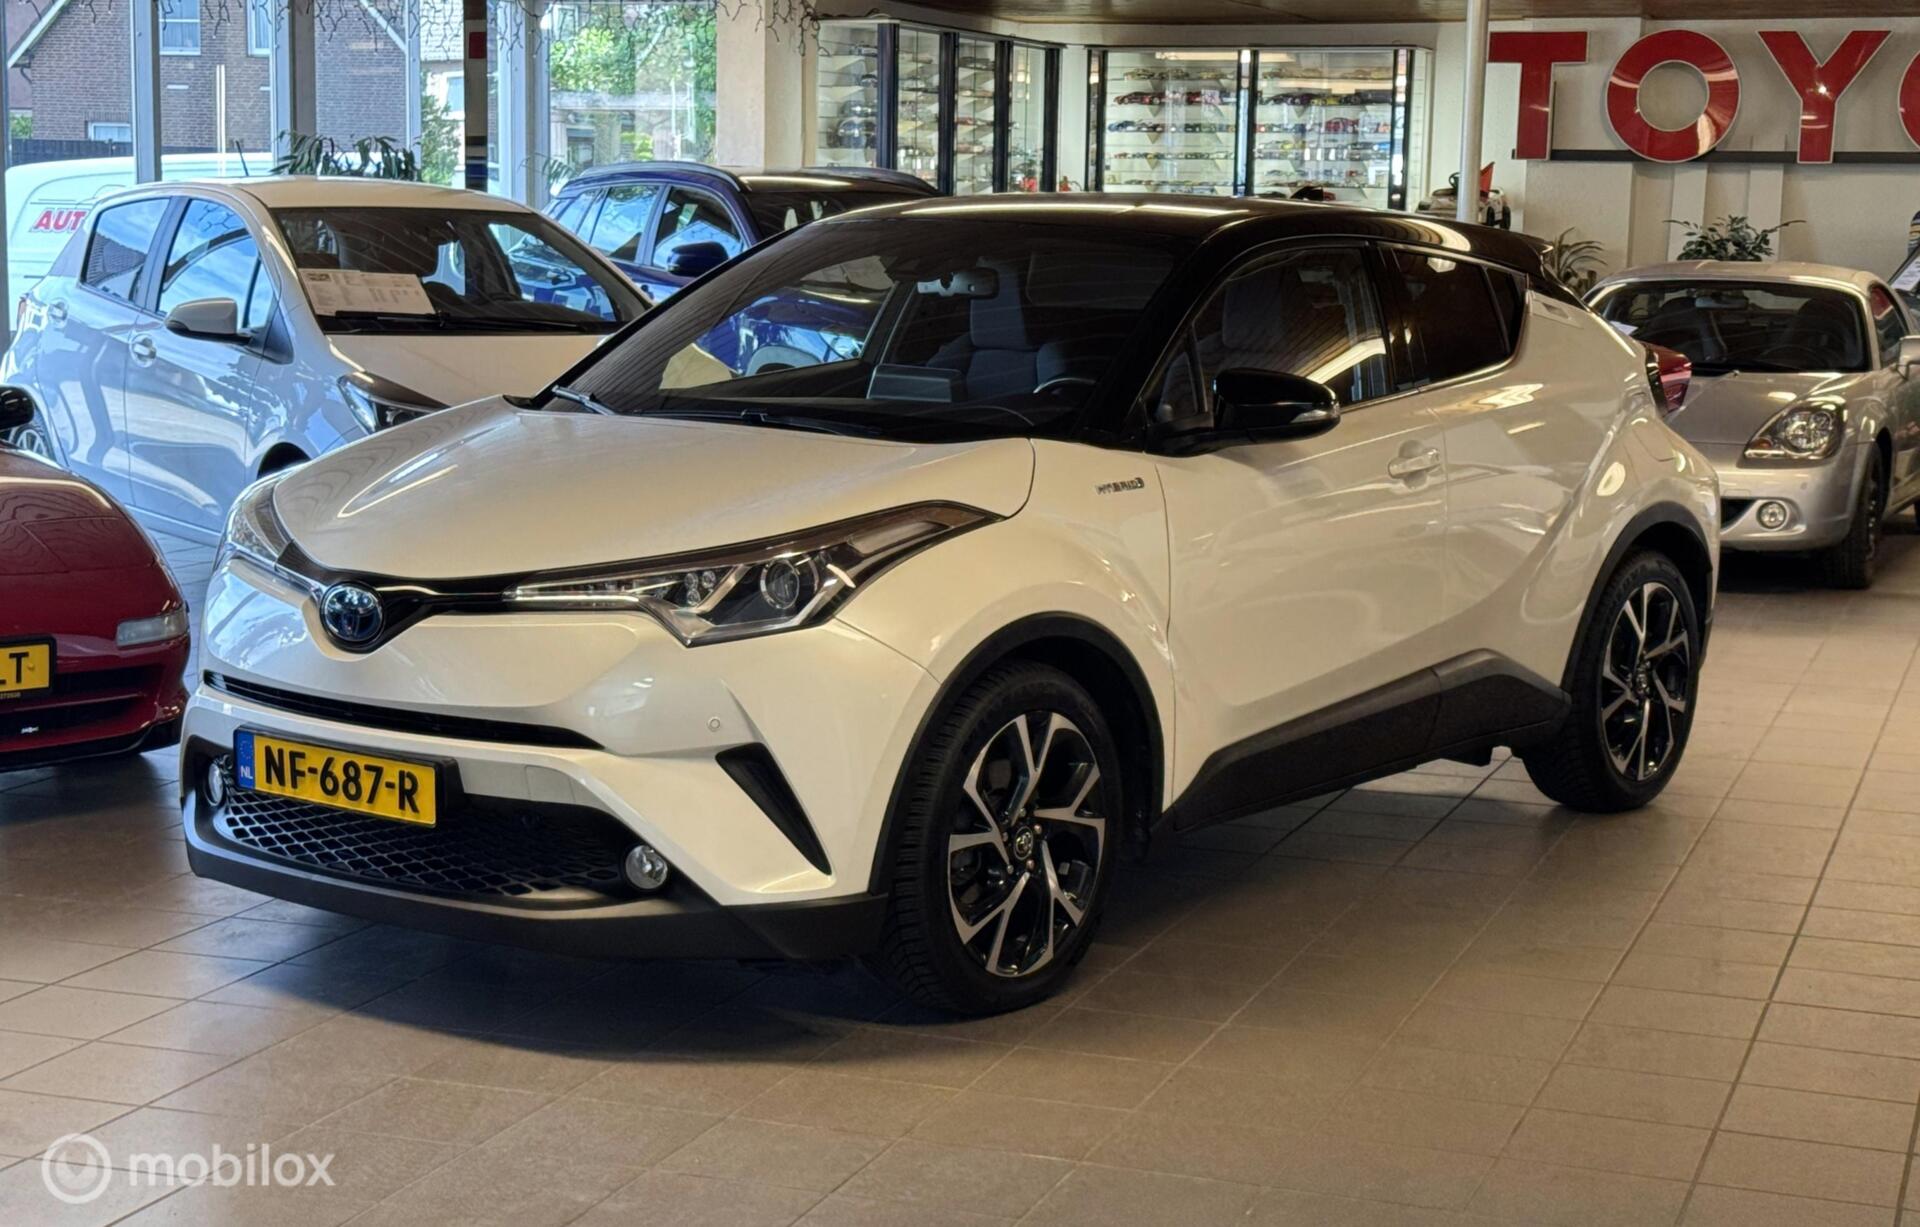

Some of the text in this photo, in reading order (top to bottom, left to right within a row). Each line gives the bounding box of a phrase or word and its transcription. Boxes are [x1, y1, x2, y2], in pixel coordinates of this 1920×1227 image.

[1487, 29, 1920, 163] TOY
[0, 652, 29, 685] T
[240, 766, 253, 780] NL
[264, 745, 420, 814] NF-687-R
